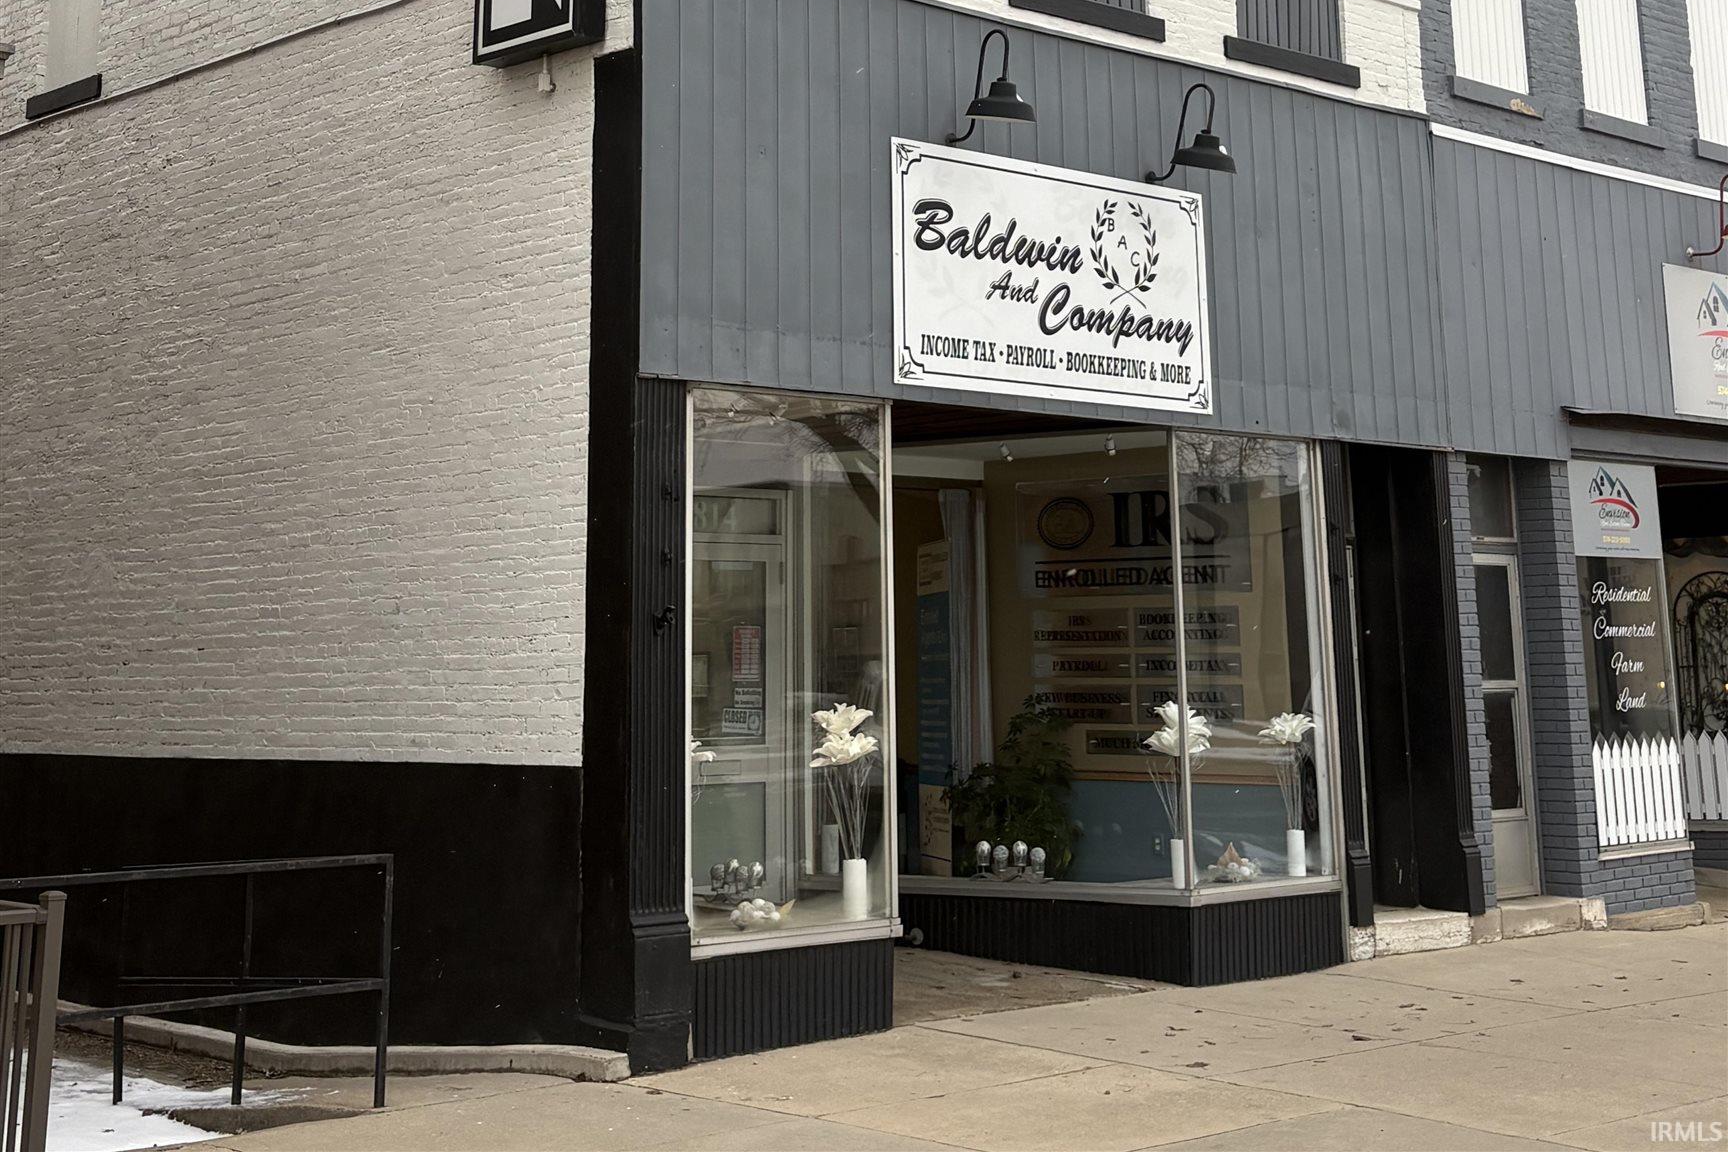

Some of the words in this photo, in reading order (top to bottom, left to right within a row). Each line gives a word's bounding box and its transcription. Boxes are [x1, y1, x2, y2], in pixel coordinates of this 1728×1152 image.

[911, 198, 1083, 274] Baldwin
[985, 269, 1040, 304] And
[1037, 281, 1194, 357] Company
[920, 334, 969, 360] INCOME
[972, 340, 996, 363] TAX
[1005, 344, 1056, 370] PAYROLL
[1065, 351, 1147, 380] BOOKKEEPING
[1149, 361, 1157, 381] &
[1160, 363, 1191, 384] MORE
[1110, 486, 1229, 548] IRS
[1035, 567, 1146, 588] ENROLLED
[1591, 581, 1652, 605] Residential
[1593, 616, 1656, 640] Commercial
[1611, 651, 1644, 676] Farm
[1616, 686, 1646, 713] Land
